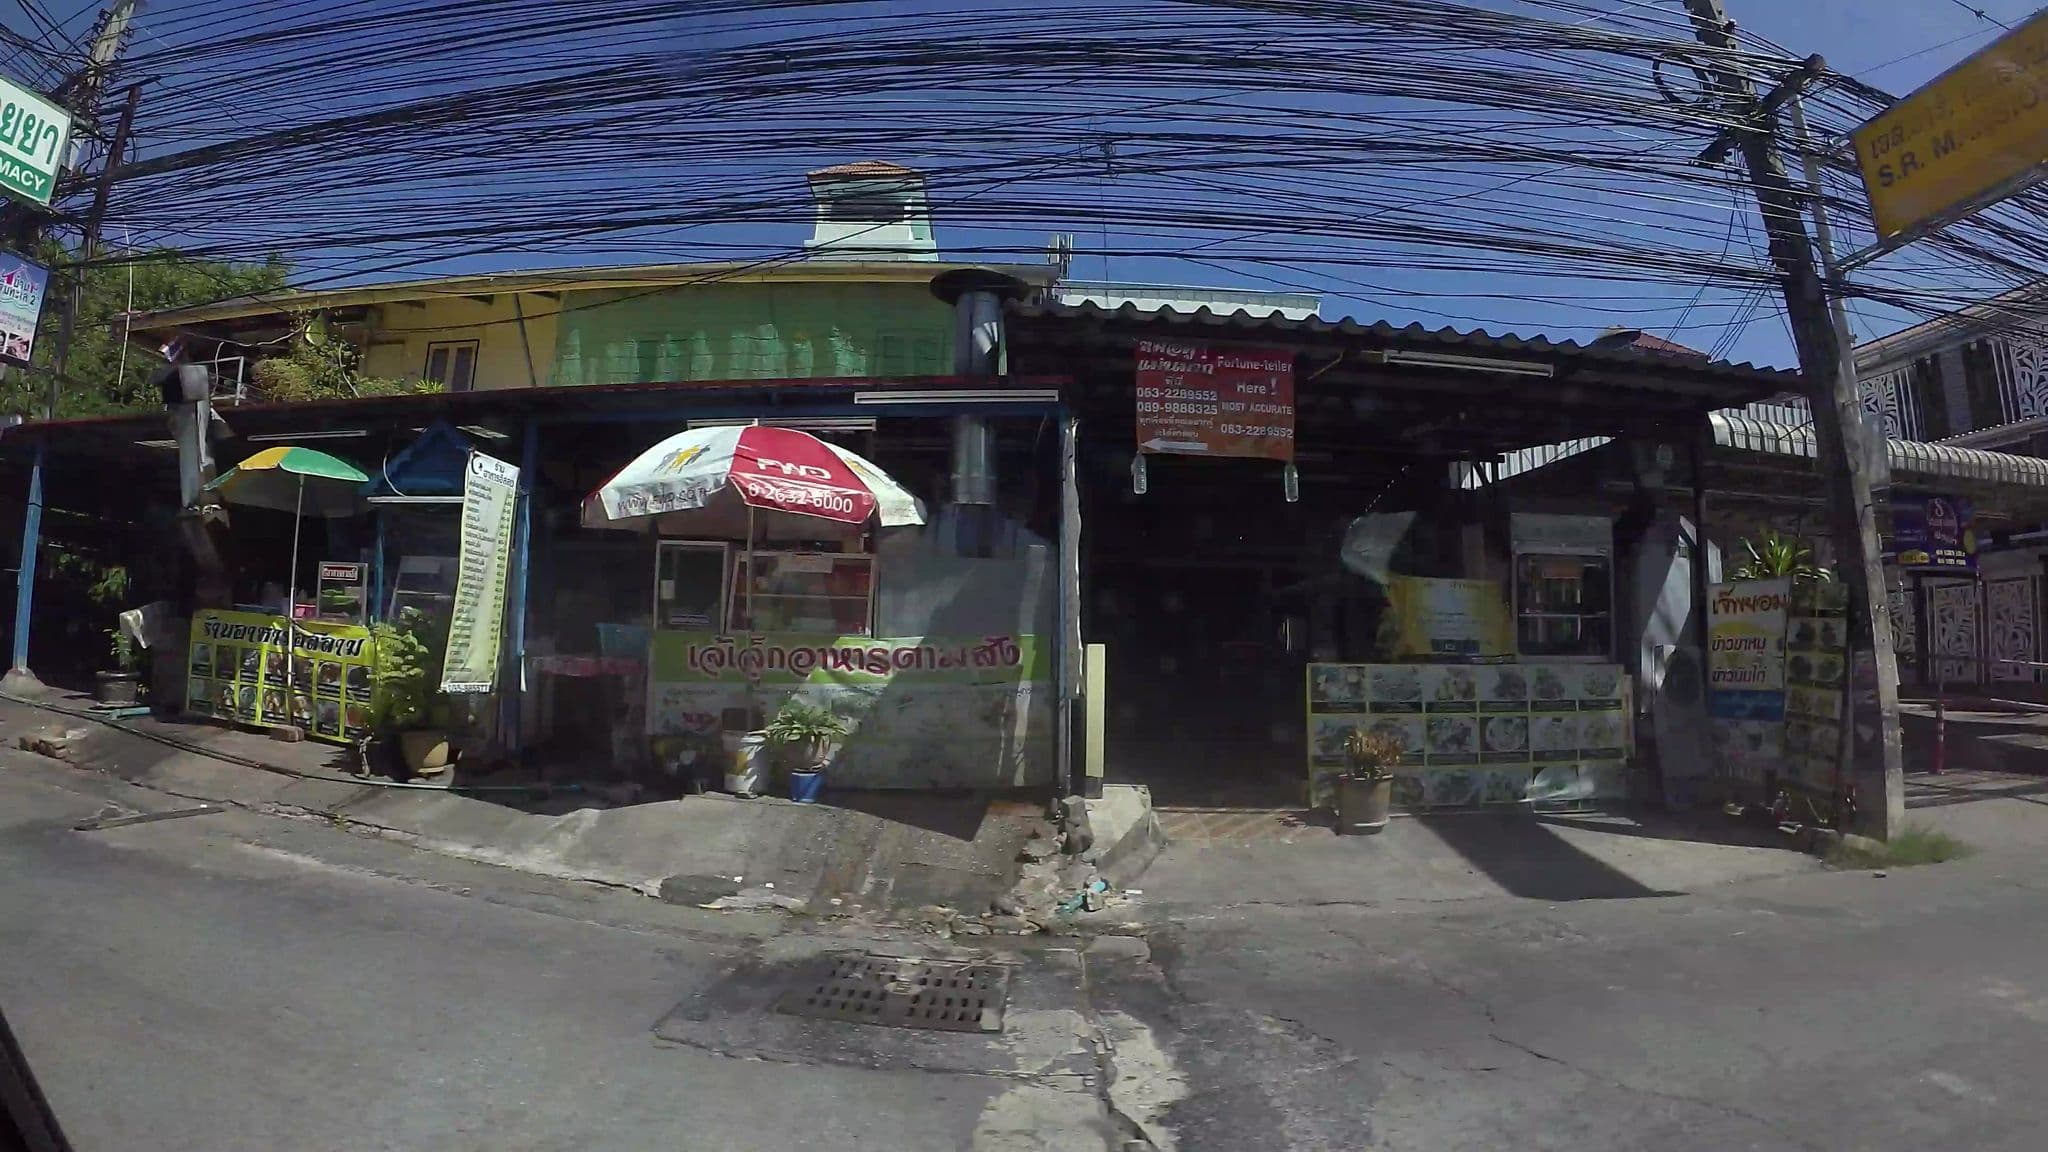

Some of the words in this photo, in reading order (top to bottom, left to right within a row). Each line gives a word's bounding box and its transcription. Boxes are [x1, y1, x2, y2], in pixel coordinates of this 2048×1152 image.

[1217, 355, 1293, 373] Fortune-teller
[1236, 383, 1267, 395] Here
[1221, 401, 1245, 412] MOST
[1249, 403, 1293, 416] ACCURATE
[757, 457, 832, 480] FWD
